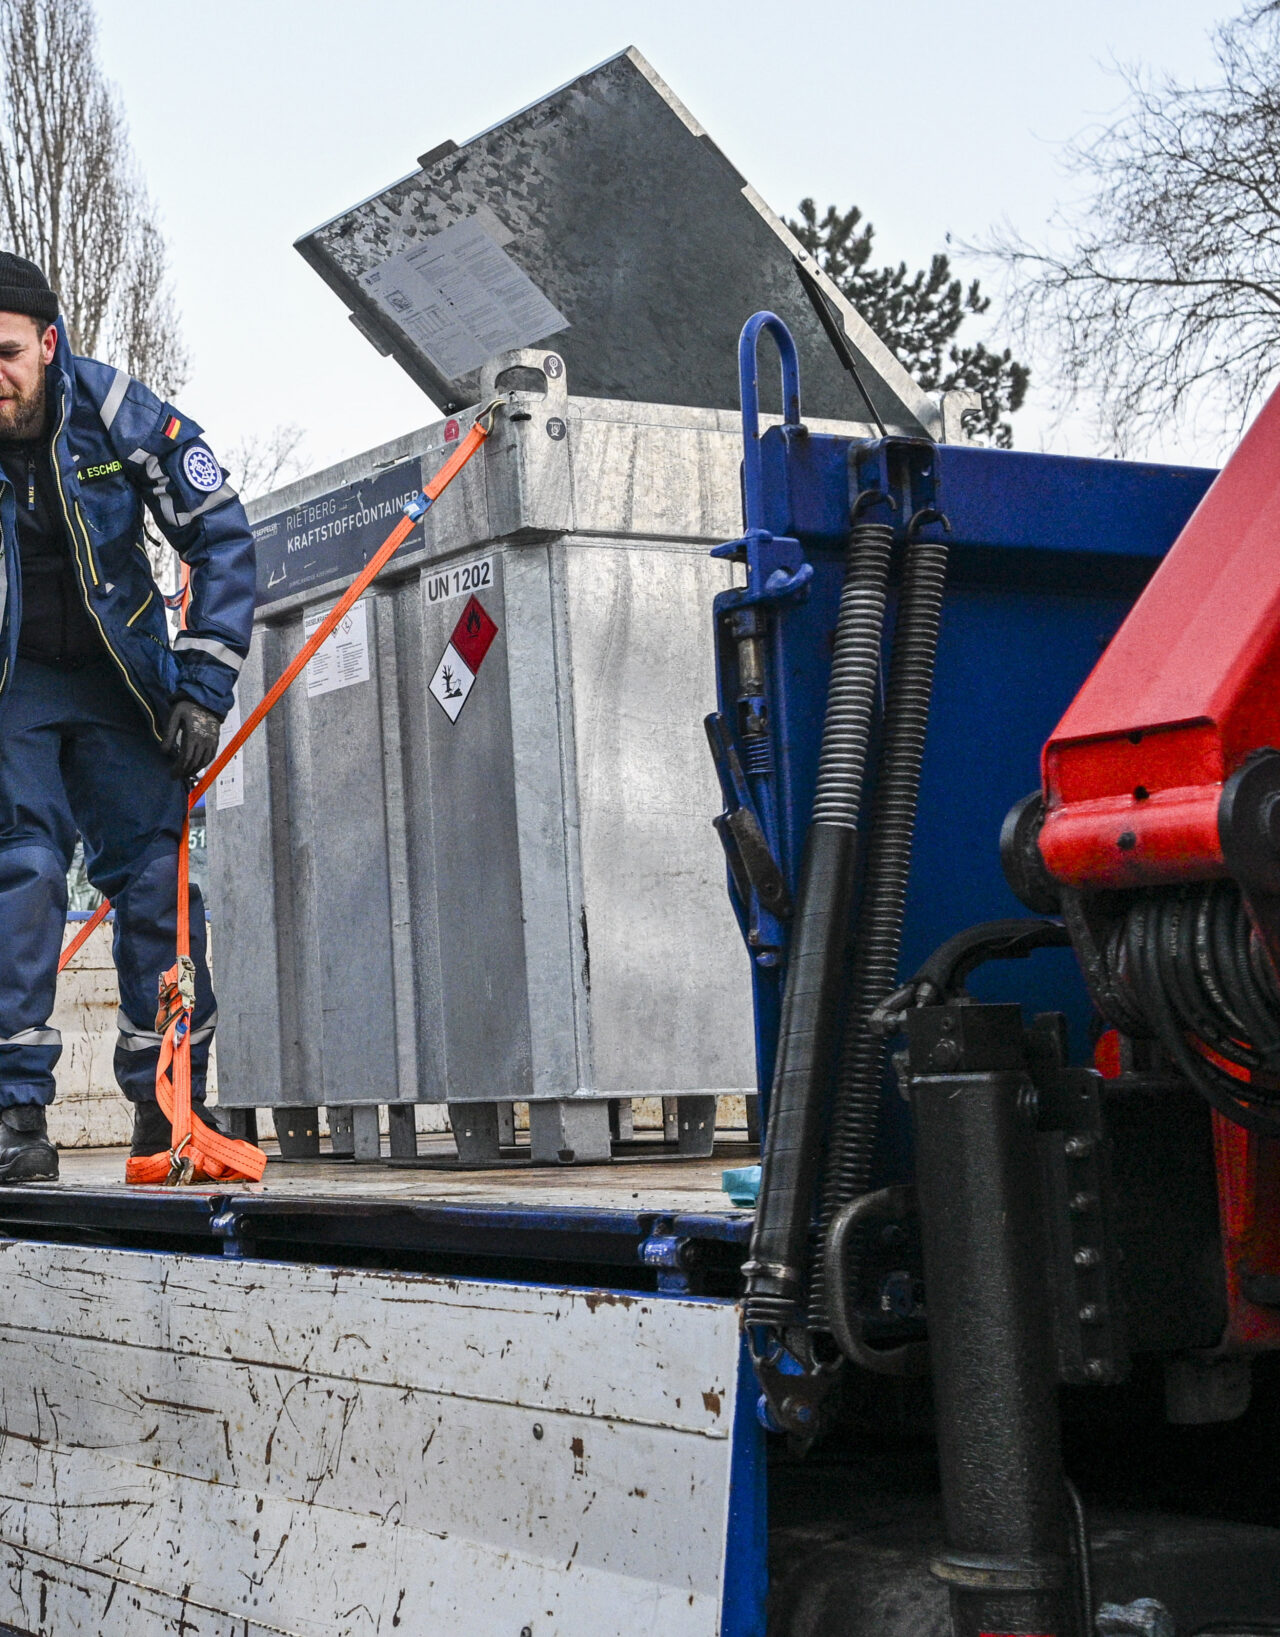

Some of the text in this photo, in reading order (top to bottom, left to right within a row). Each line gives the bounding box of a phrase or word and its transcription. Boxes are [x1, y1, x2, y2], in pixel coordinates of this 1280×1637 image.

[286, 498, 337, 532] RIETBERG
[428, 561, 491, 602] UN 1202
[188, 828, 206, 850] 51
